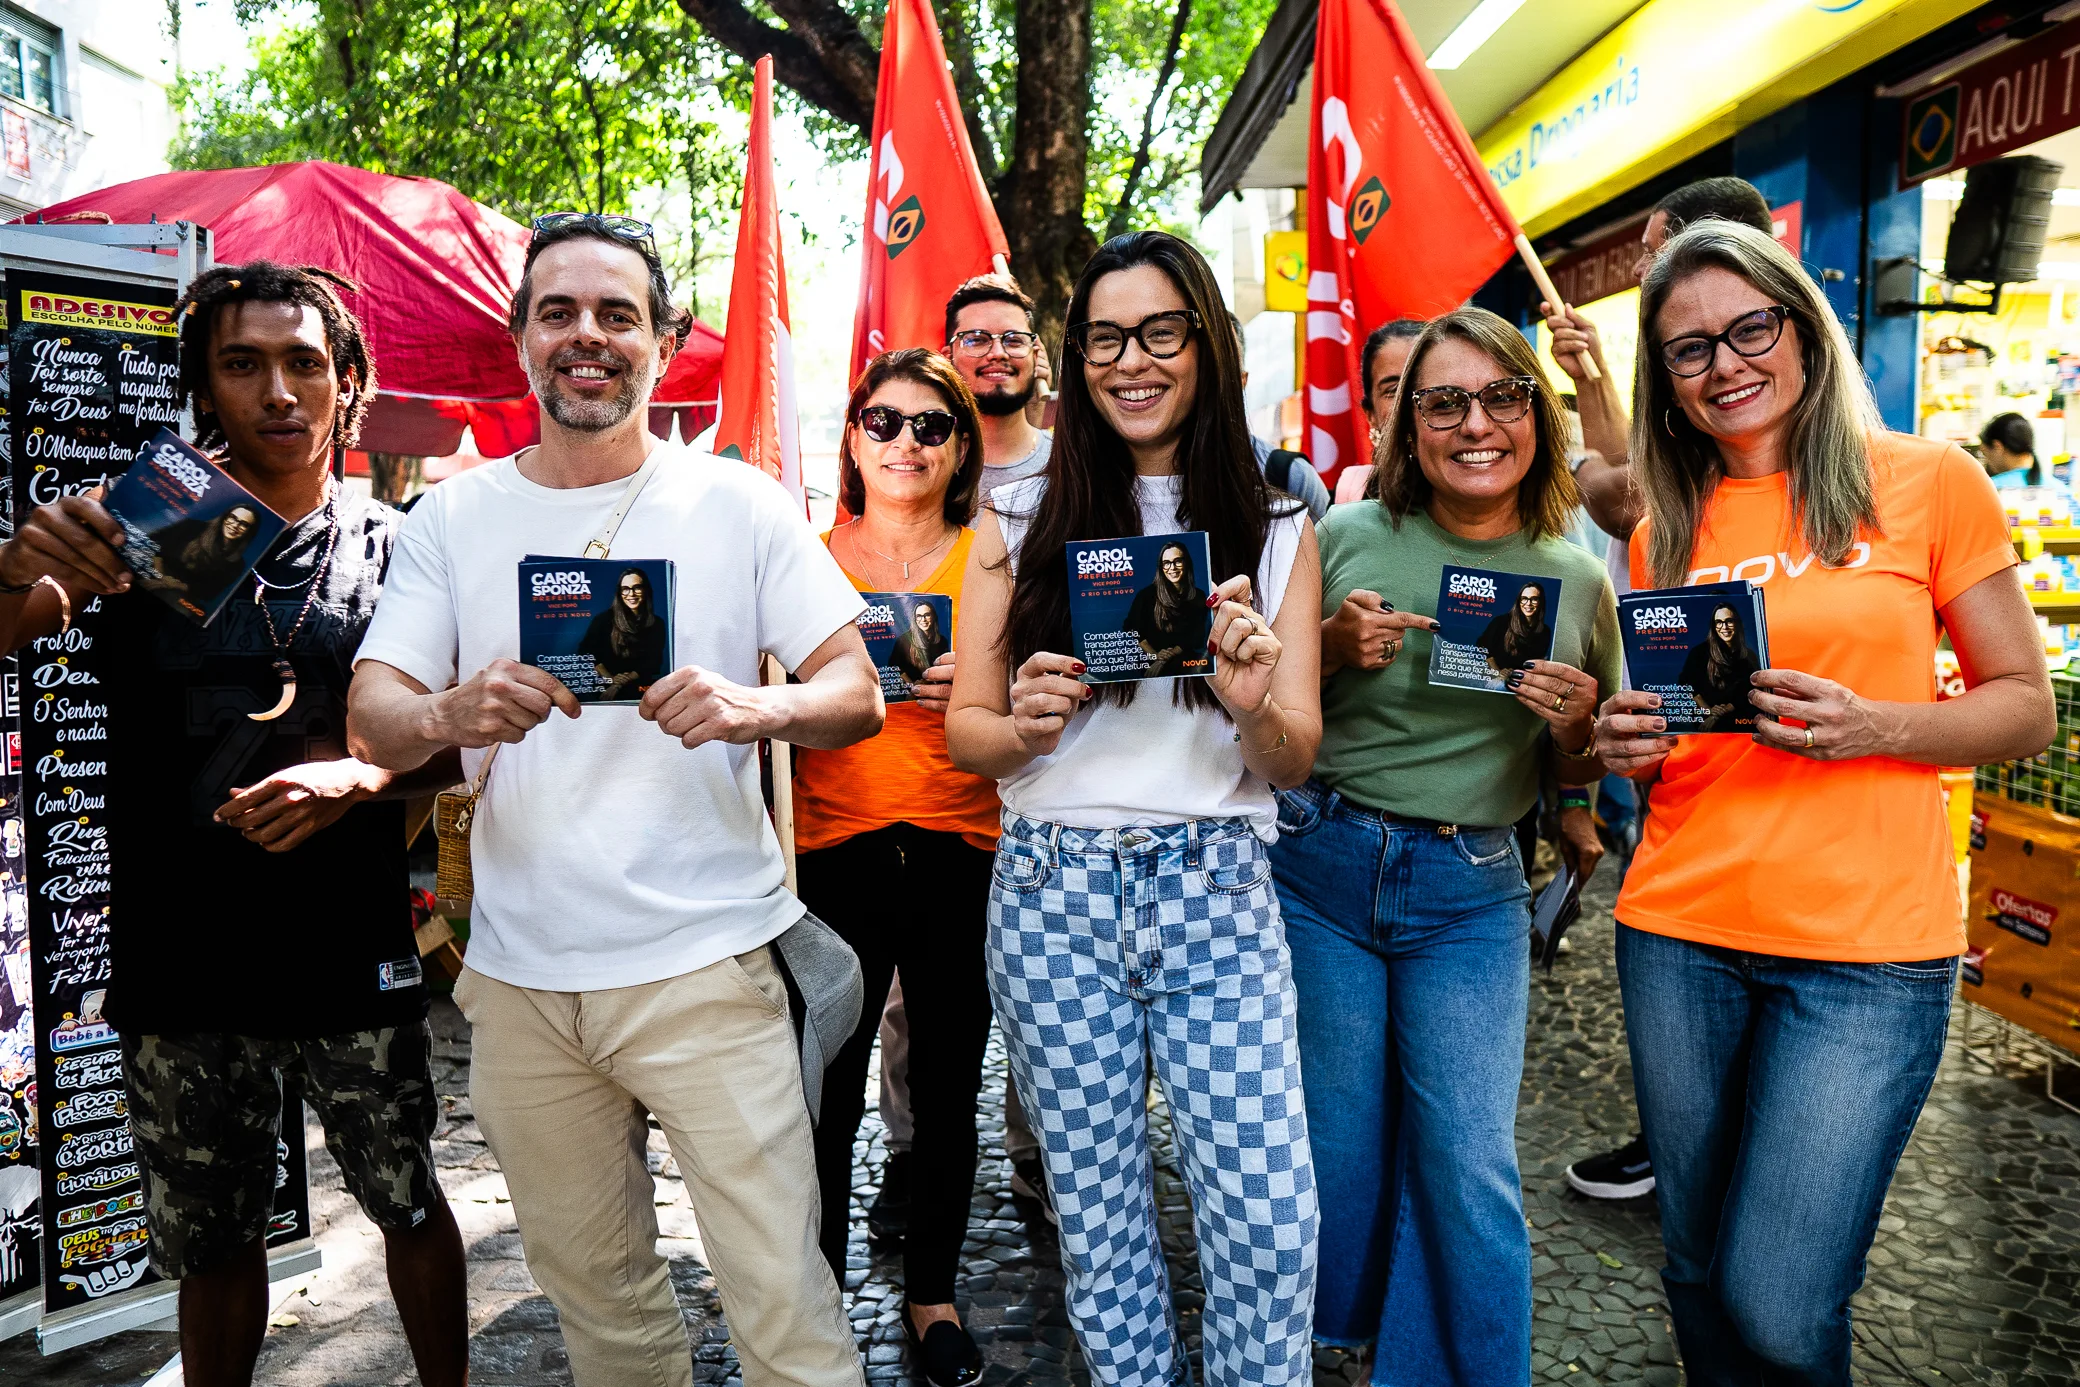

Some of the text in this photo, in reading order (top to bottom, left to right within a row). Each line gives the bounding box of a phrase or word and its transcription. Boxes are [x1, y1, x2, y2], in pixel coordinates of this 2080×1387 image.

[1960, 44, 2080, 155] AQUI T
[29, 295, 178, 325] ADESIVO
[31, 312, 95, 325] ESCOLHA
[98, 319, 132, 329] PELO
[33, 338, 102, 368] Nunca
[118, 350, 156, 376] Tudo
[29, 360, 107, 387] foi sorte,
[42, 381, 96, 398] sempre
[120, 379, 174, 403] naquele
[27, 397, 111, 422] foi Deus
[119, 403, 136, 414] me
[26, 433, 41, 457] O
[43, 434, 108, 465] Moleque
[108, 441, 136, 461] tem
[160, 443, 212, 489] CAROL
[152, 453, 204, 497] SPONZA
[1077, 547, 1133, 564] CAROL
[1078, 560, 1133, 574] SPONZA
[1078, 571, 1122, 580] PREFEITA
[531, 571, 591, 585] CAROL
[1450, 573, 1498, 590] CAROL
[532, 584, 591, 596] SPONZA
[1448, 583, 1495, 599] SPONZA
[1632, 605, 1687, 621] CAROL
[1634, 618, 1688, 630] SPONZA
[65, 628, 93, 653] De
[1084, 638, 1139, 649] transparência
[1086, 652, 1157, 665] Tudo que faz falta
[1183, 659, 1208, 668] NOVO
[1087, 662, 1151, 673] nessa prefeitura.
[1437, 669, 1458, 677] nessa
[1439, 660, 1500, 677] Tudo que faz falta
[581, 677, 594, 685] faz
[595, 676, 613, 685] falta
[34, 698, 108, 722] O Senhor
[1665, 707, 1680, 715] que
[1681, 706, 1693, 715] faz
[1693, 706, 1711, 715] falta
[1667, 715, 1705, 724] prefeitura.
[56, 722, 107, 742] e nada
[36, 755, 107, 782] Presen
[35, 789, 105, 816] Com Deus
[48, 820, 107, 851] Que
[91, 838, 108, 851] a
[1996, 891, 2052, 926] Ofertas
[52, 908, 107, 933] Viver
[76, 928, 84, 937] e
[58, 935, 80, 951] ter
[77, 956, 94, 971] de
[58, 1030, 93, 1045] Bebê
[96, 1030, 104, 1039] a
[60, 1074, 78, 1086] OS
[75, 1092, 118, 1111] FOCO
[61, 1207, 92, 1224] THE
[63, 1229, 100, 1248] DEUS
[65, 1228, 149, 1260] FOGUETE
